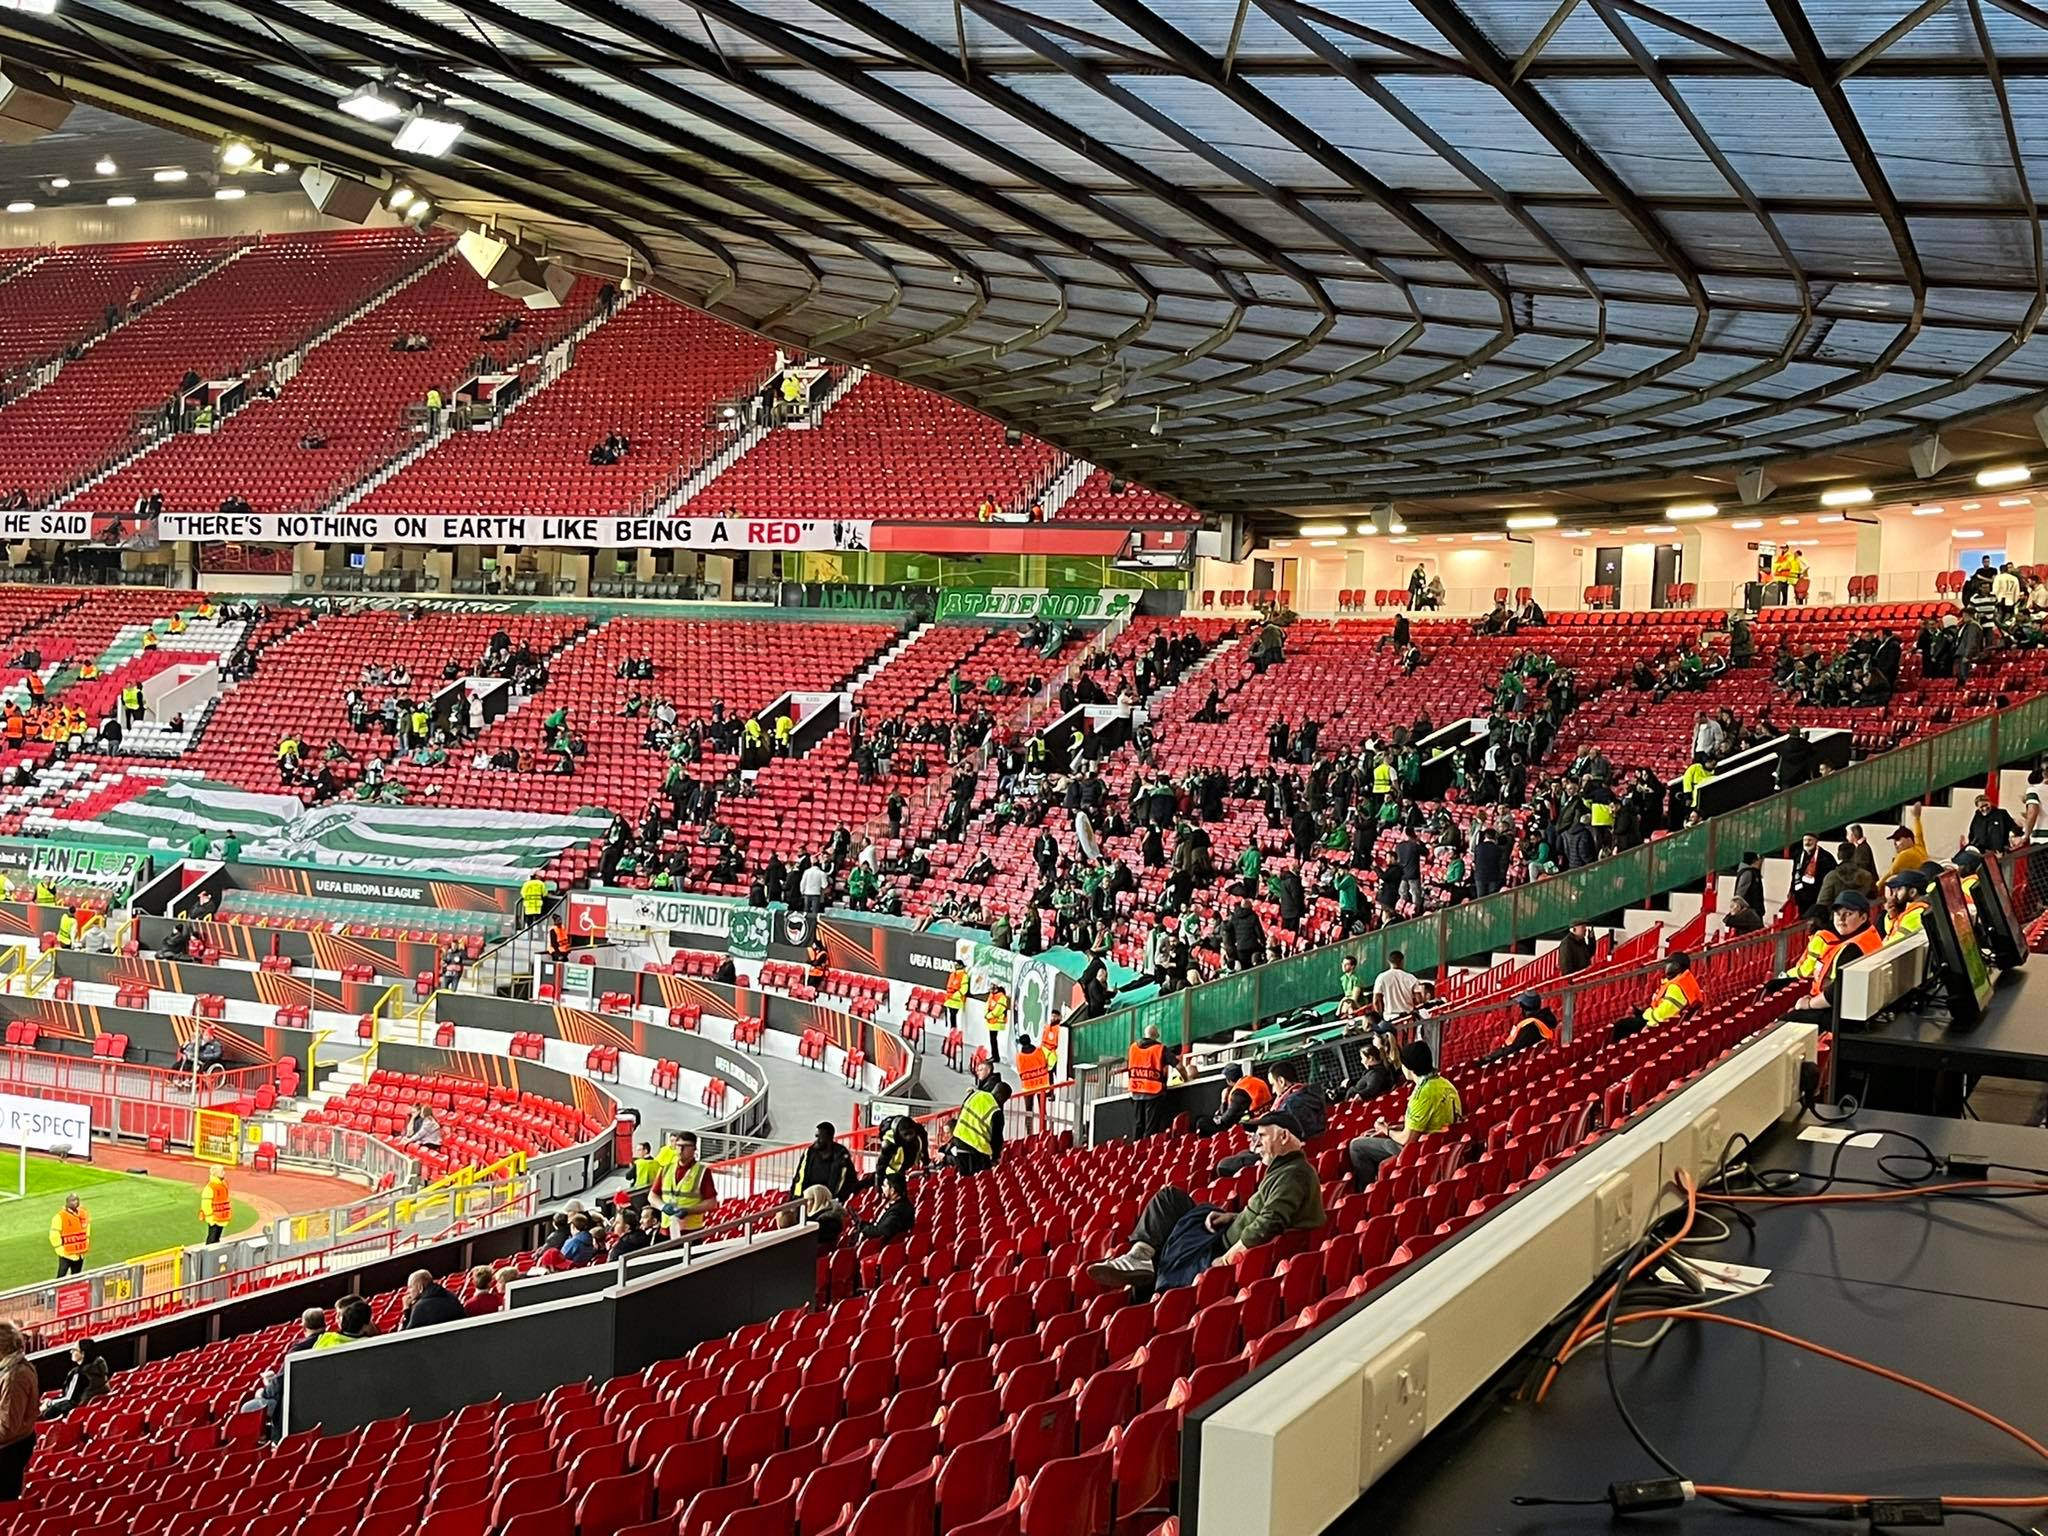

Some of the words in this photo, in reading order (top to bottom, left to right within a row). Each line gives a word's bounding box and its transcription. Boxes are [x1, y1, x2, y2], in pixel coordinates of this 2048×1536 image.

[4, 514, 31, 533] HE
[40, 515, 88, 535] SAID
[163, 515, 262, 536] "THERE'S
[277, 517, 378, 538] NOTHING
[394, 517, 427, 538] ON
[443, 517, 526, 540] EARTH
[542, 519, 598, 541] LIKE
[616, 519, 692, 542] BEING
[710, 521, 729, 543] A
[748, 521, 815, 545] RED"
[943, 593, 1103, 616] ATHIENOU
[34, 846, 71, 873] FAN
[315, 880, 342, 893] UEFA
[342, 882, 381, 896] EUROPA
[382, 885, 421, 899] LEAGUE
[910, 953, 932, 969] UEFA
